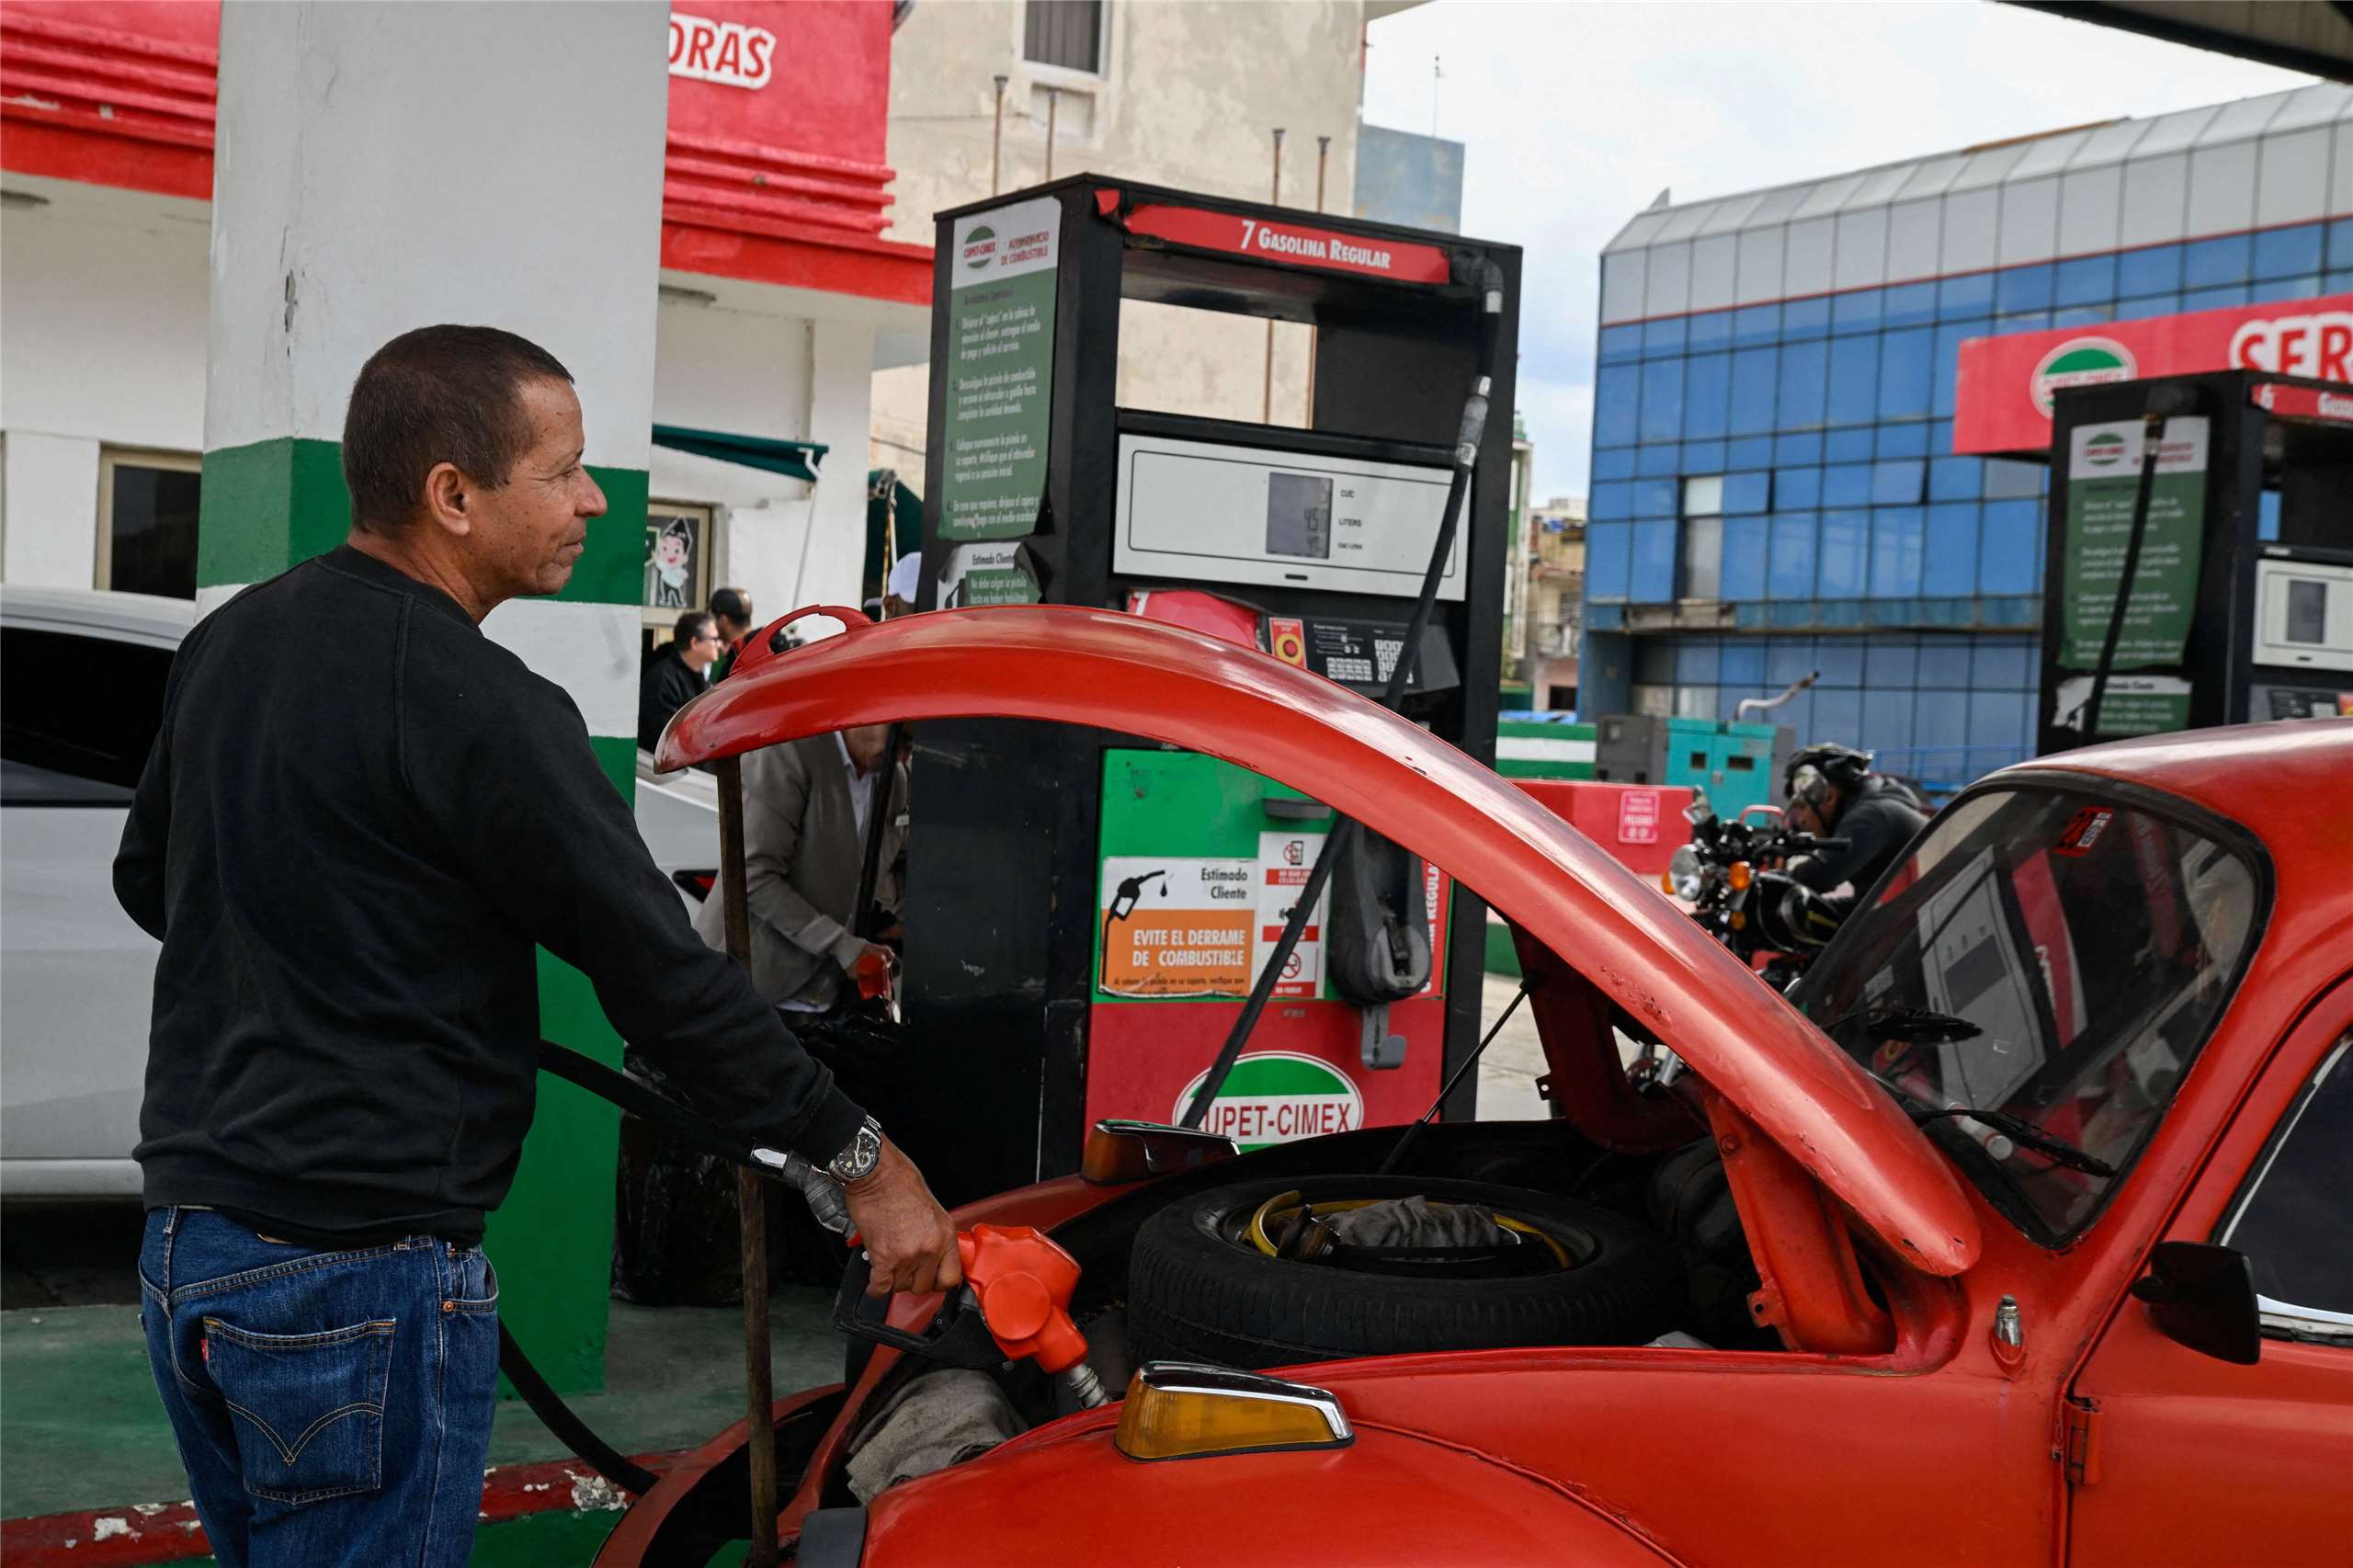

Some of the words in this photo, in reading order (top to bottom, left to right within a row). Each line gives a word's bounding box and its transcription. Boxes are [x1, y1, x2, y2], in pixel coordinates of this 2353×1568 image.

[1241, 220, 1256, 250] 7
[1258, 227, 1326, 258] GASOLINA
[1330, 239, 1392, 269] REGULAR
[1201, 868, 1248, 881] Estimado
[1211, 887, 1246, 900] Cliente
[1133, 929, 1167, 946] EVITE
[1171, 929, 1185, 946] EL
[1188, 929, 1245, 946] DERRAME
[1132, 951, 1150, 967] DE
[1158, 950, 1245, 967] COMBUSTIBLE
[1199, 1103, 1351, 1136] UPET-CIMEX
